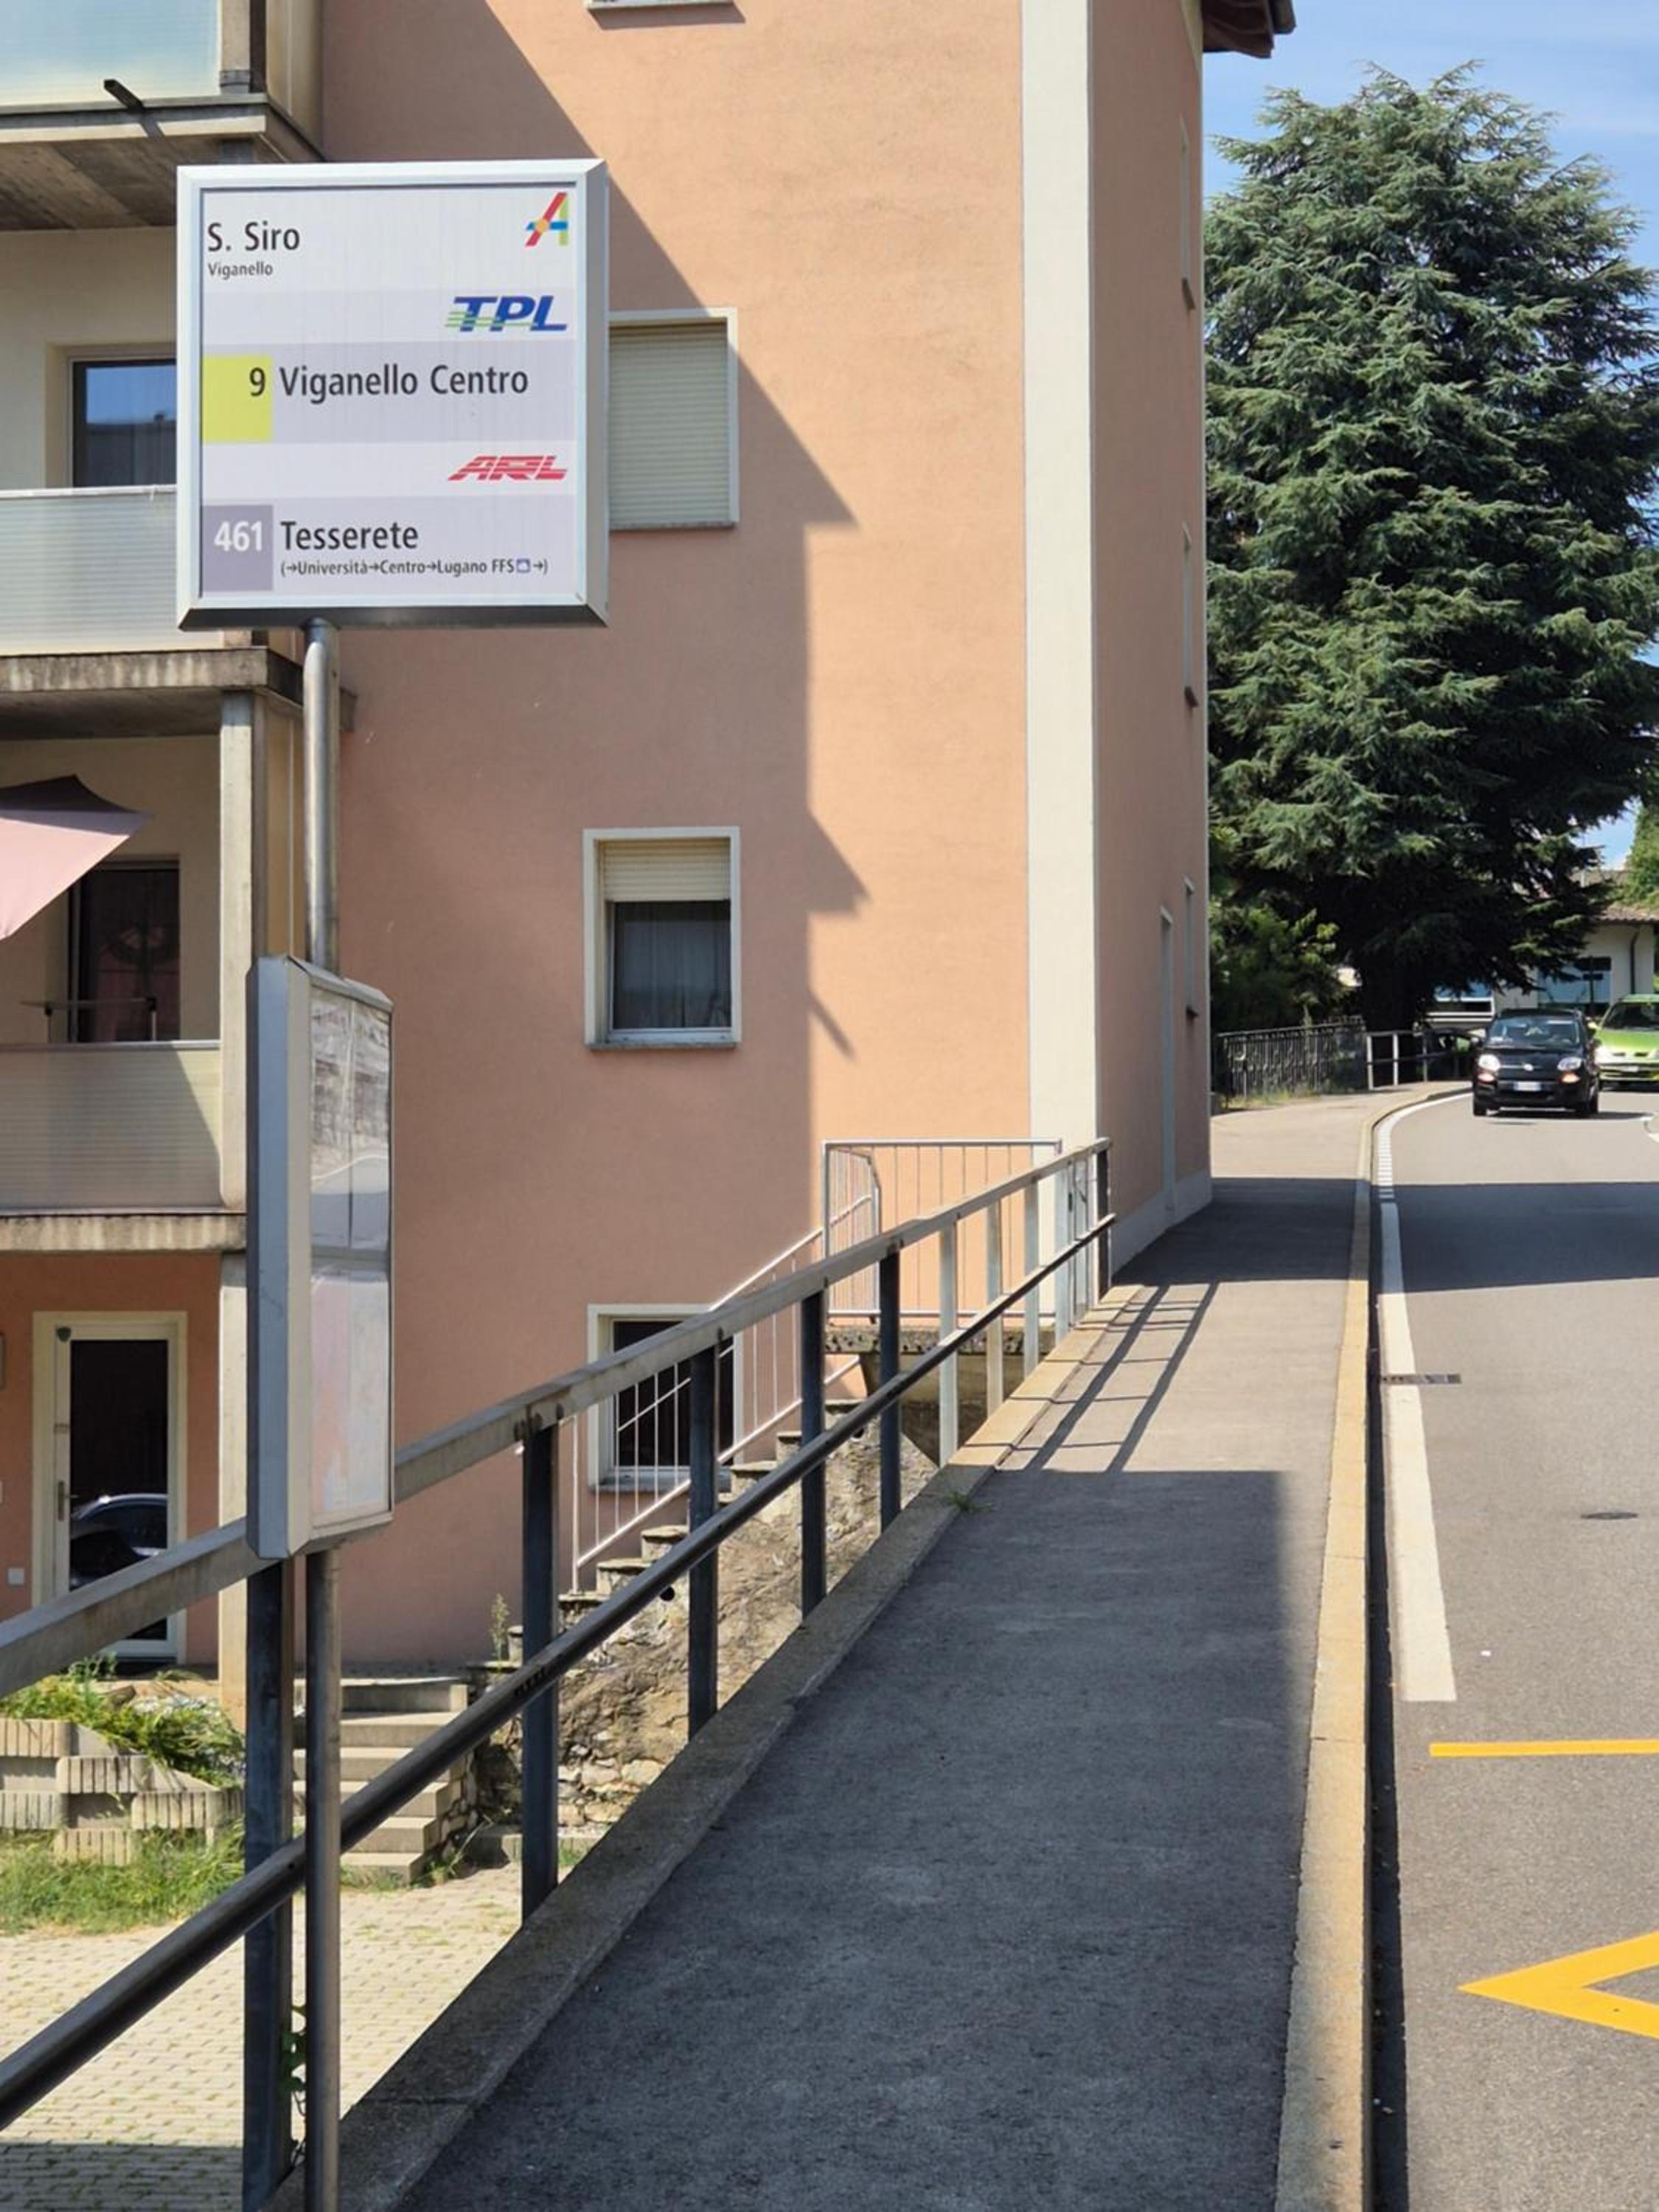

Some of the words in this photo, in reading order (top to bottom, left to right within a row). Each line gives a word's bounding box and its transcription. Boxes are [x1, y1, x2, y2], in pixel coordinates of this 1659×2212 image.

[207, 222, 232, 252] S.
[245, 220, 300, 251] Siro
[207, 261, 274, 280] Viganello
[449, 295, 568, 332] TPL
[249, 366, 266, 397] 9
[279, 363, 418, 405] Viganello
[430, 364, 529, 394] Centro
[448, 455, 568, 481] ARL
[214, 521, 262, 552] 461
[280, 521, 419, 551] Tesserete
[492, 558, 515, 574] FFS
